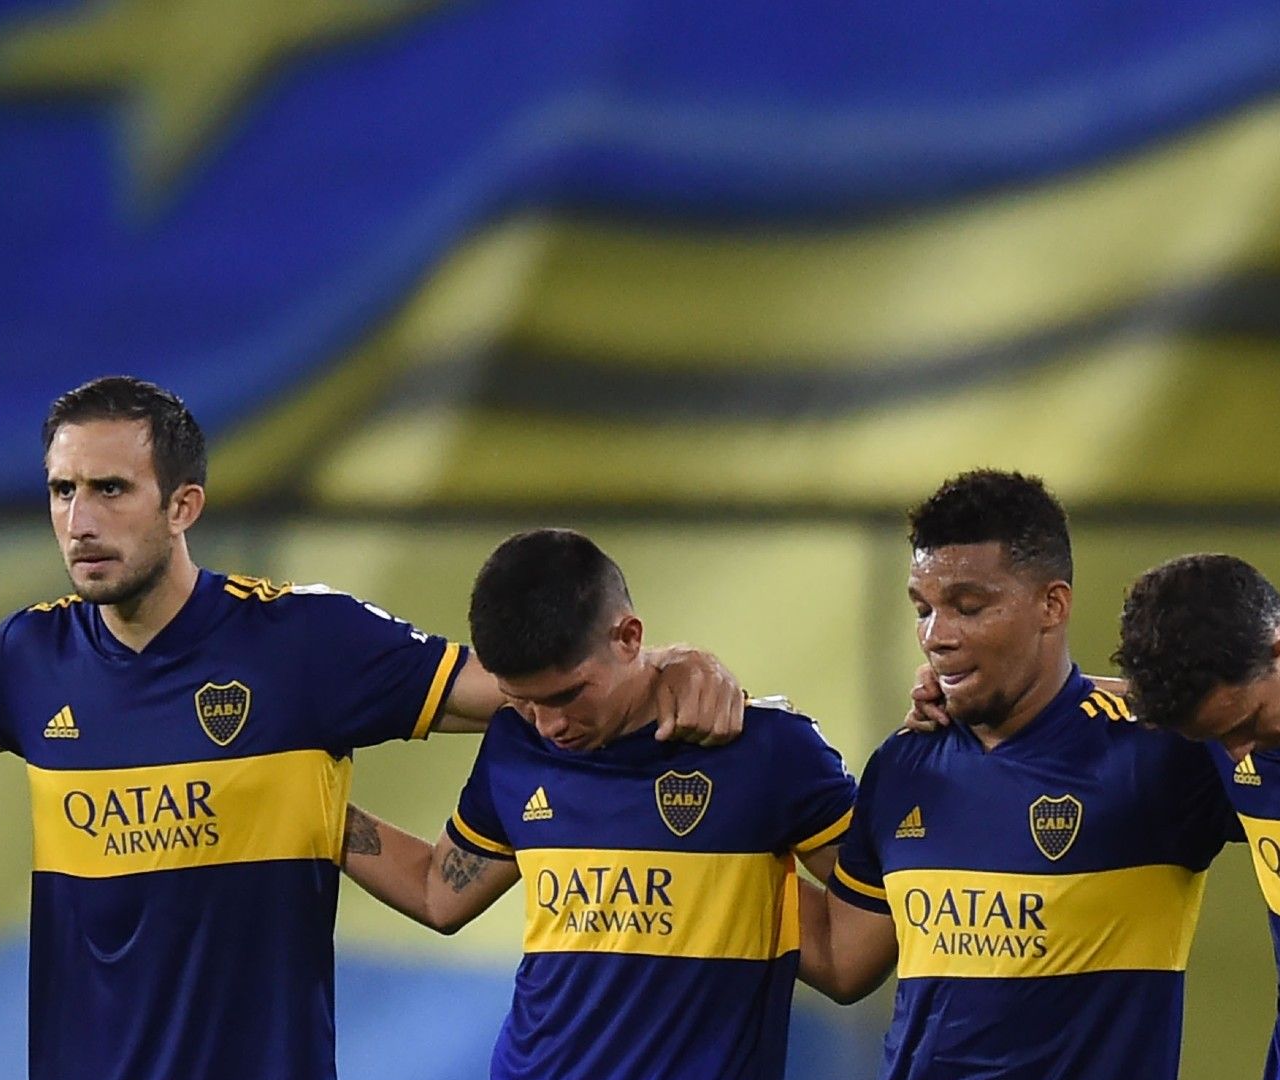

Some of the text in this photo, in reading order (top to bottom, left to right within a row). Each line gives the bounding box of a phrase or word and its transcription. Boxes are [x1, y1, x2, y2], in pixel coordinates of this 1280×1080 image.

[203, 702, 242, 718] CABJ
[63, 780, 218, 837] QATAR
[663, 792, 702, 806] CABJ
[104, 822, 219, 857] AIRWAYS
[537, 867, 673, 915] QATAR
[564, 909, 673, 937] AIRWAYS
[904, 888, 1048, 935] QATAR
[932, 931, 1048, 959] AIRWAYS
